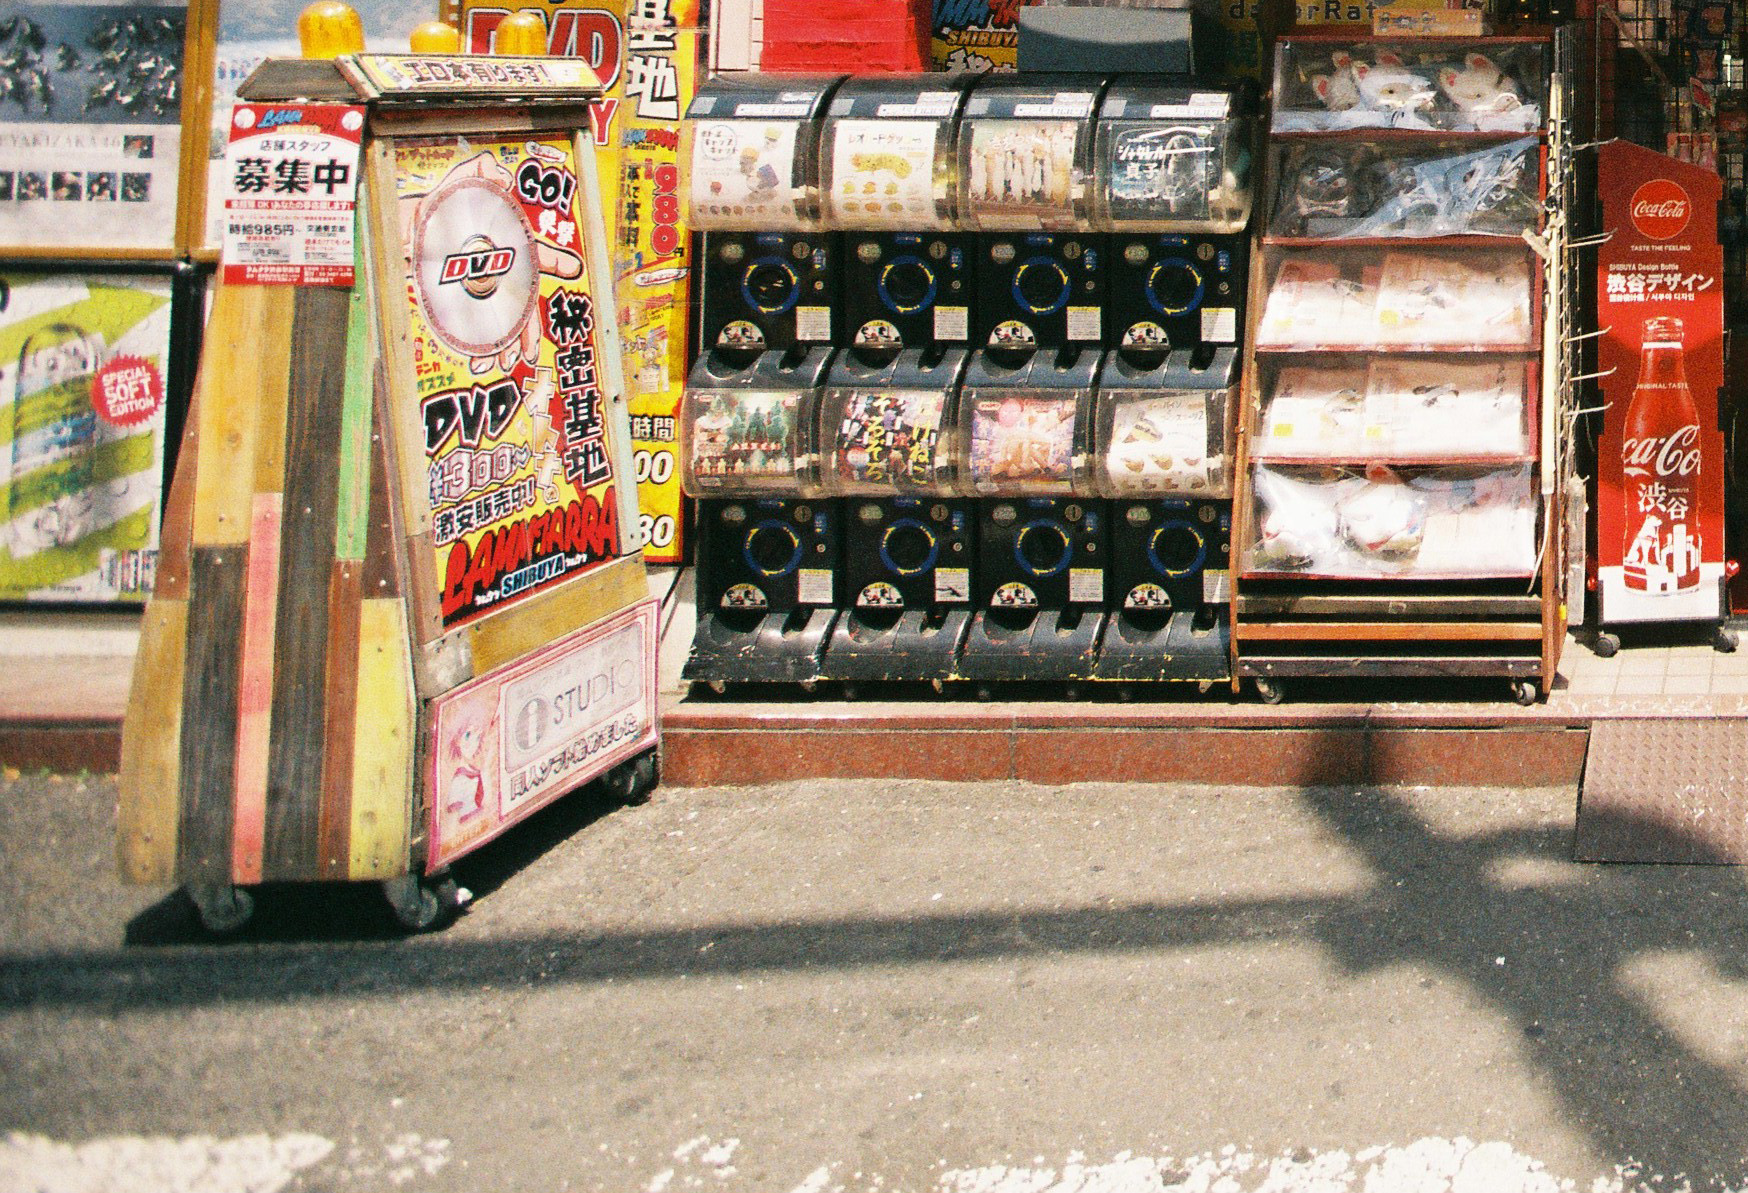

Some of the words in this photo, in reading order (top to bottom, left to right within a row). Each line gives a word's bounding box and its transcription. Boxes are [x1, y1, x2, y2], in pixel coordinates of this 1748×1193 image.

[947, 30, 1019, 47] SHIBUY
[235, 158, 350, 194] 募集中
[515, 158, 577, 219] GO!
[439, 247, 516, 285] DVD
[1609, 263, 1636, 271] SHIBUYA
[1607, 273, 1714, 293] 渋谷デザイン
[102, 365, 150, 386] SPECIAL
[546, 288, 612, 488] 秘密基地
[104, 377, 151, 404] SOFT
[109, 396, 155, 418] EDITION
[422, 381, 521, 454] DVD
[629, 415, 676, 442] 時間
[502, 554, 565, 597] SHIBUYA
